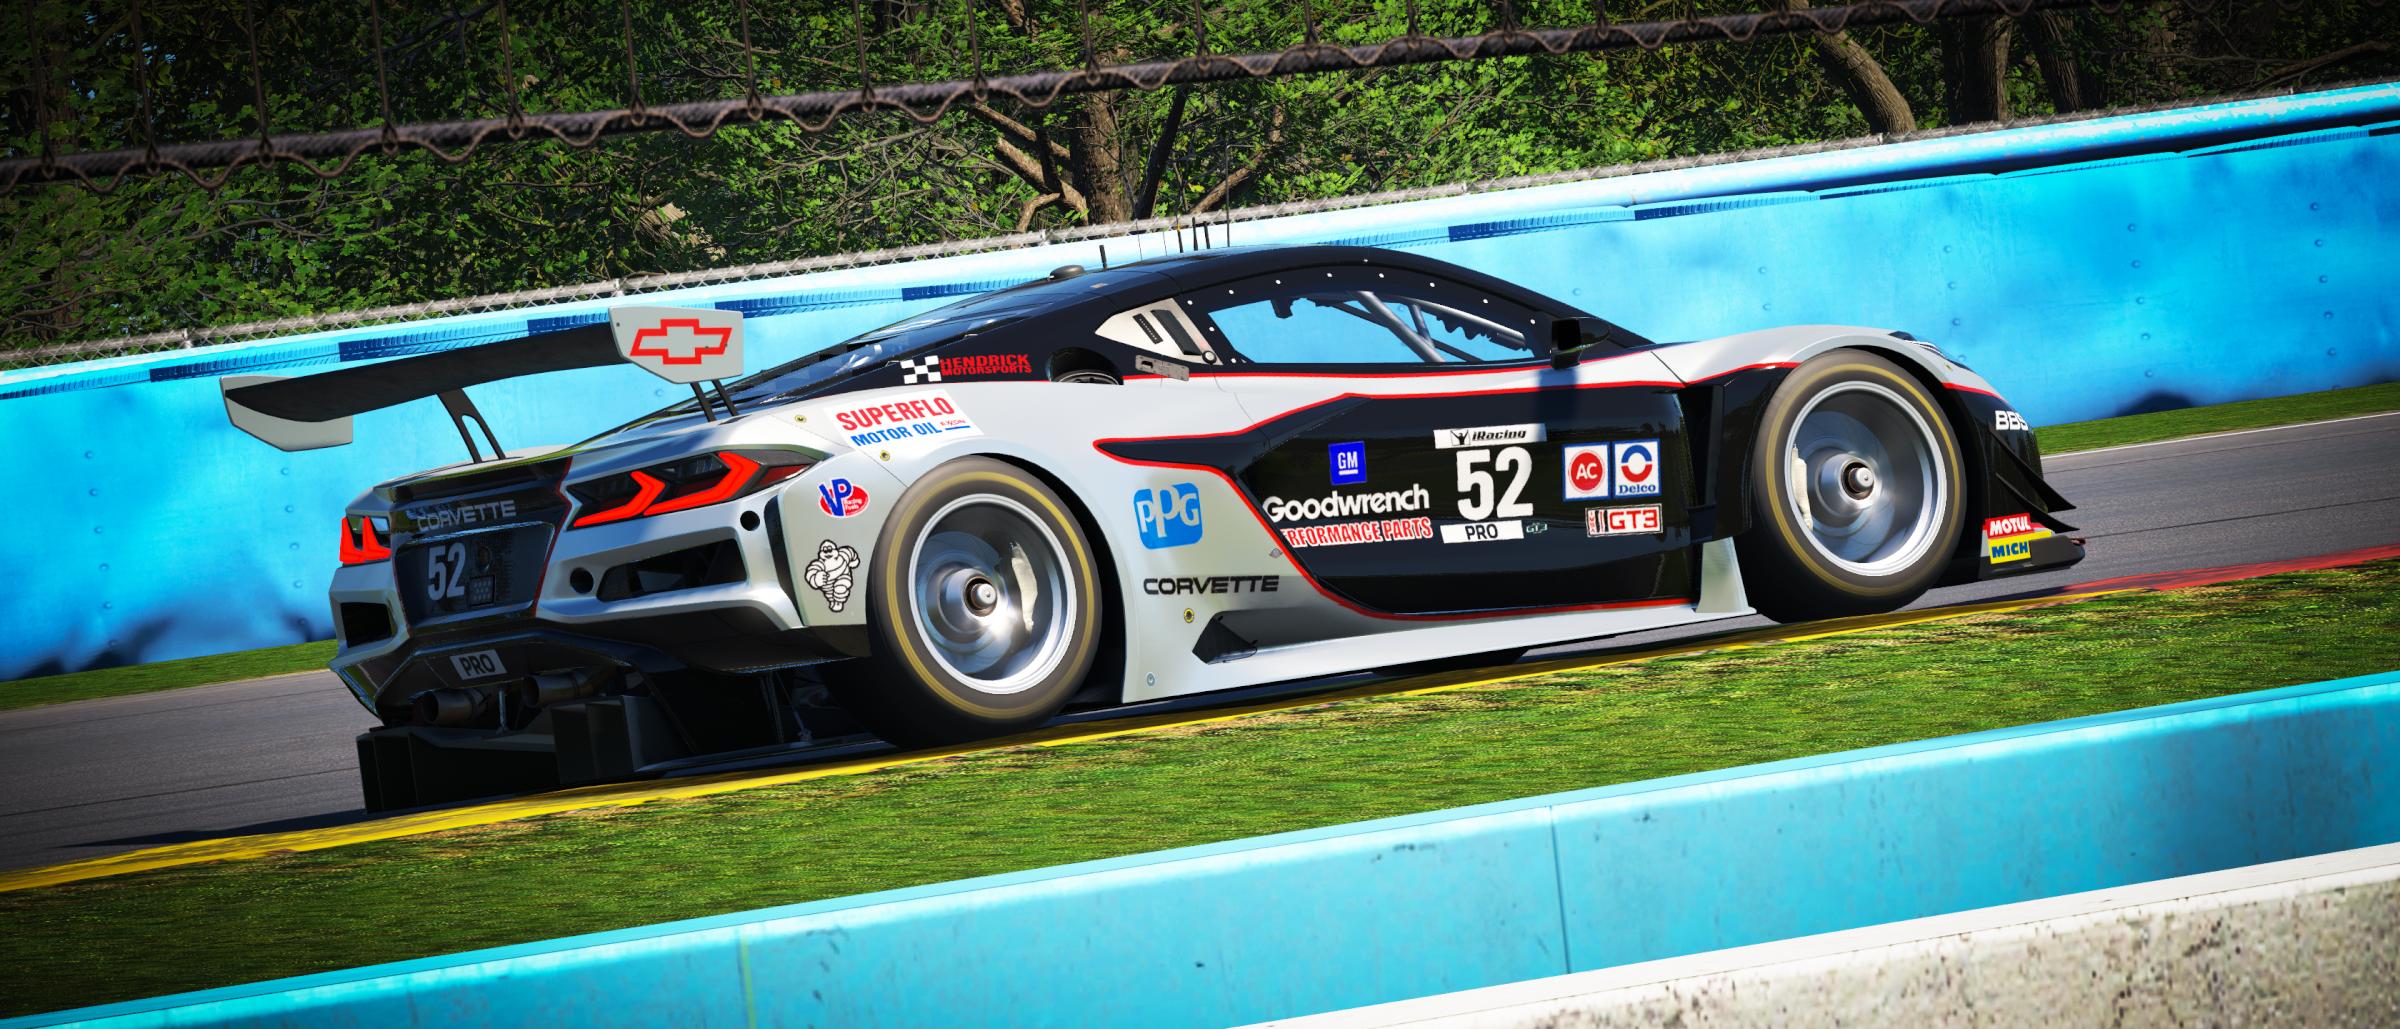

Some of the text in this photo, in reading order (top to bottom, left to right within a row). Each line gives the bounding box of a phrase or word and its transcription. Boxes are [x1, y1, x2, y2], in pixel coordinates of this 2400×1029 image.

[940, 354, 1029, 368] HENDRICK
[941, 365, 1032, 376] MOTORSPORTS
[836, 397, 955, 431] SUPERFLO
[1995, 410, 2029, 431] BBS
[850, 422, 942, 446] MOTOR OIL
[1472, 430, 1527, 441] iRacing
[1337, 451, 1359, 469] GM
[1576, 462, 1598, 480] AC
[1456, 446, 1533, 521] 52
[1619, 484, 1656, 494] Delco
[819, 479, 852, 516] VP
[1262, 483, 1429, 523] Goodwrench
[417, 499, 517, 532] CORVETTE
[1609, 509, 1658, 530] GT3
[1382, 517, 1433, 541] PARTS
[1465, 524, 1498, 540] PRO
[1989, 516, 2031, 537] MOTUL
[1992, 542, 2029, 559] MICH
[428, 542, 466, 600] 52
[1143, 575, 1280, 595] CORVETTE
[458, 653, 496, 677] PRO
